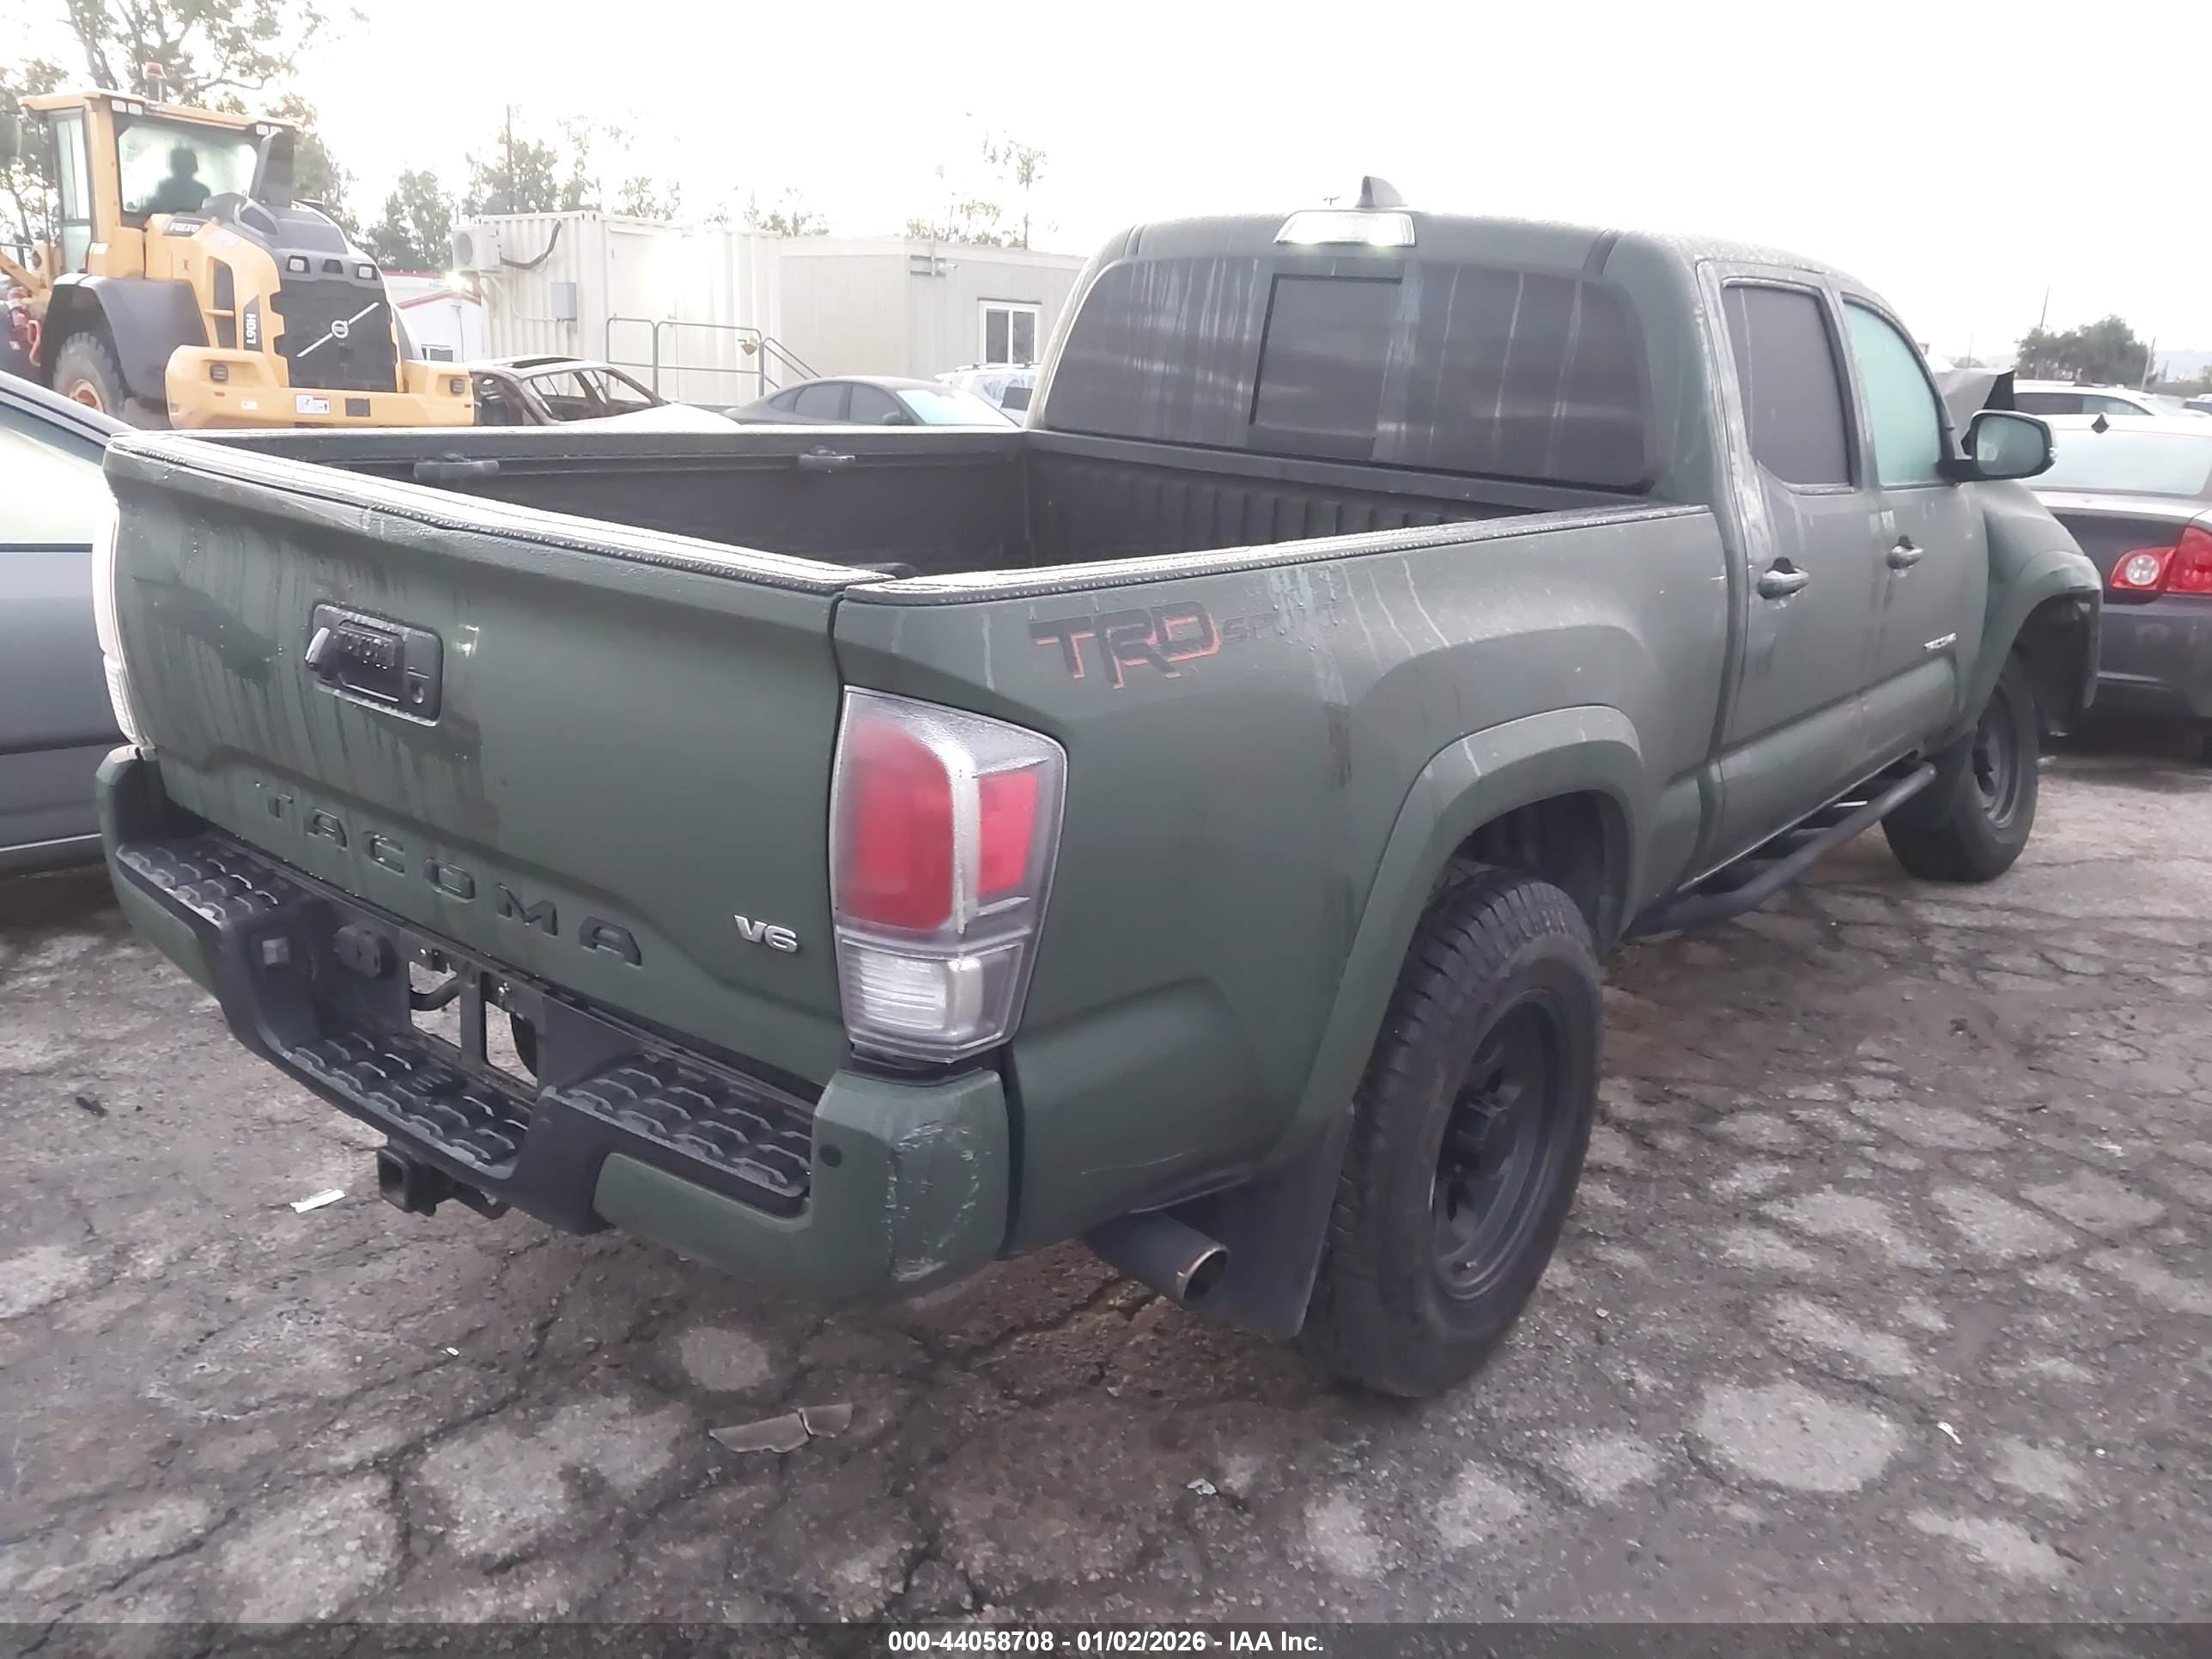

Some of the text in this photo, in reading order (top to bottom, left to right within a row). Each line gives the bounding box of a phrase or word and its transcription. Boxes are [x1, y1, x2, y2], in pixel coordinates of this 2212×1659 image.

[246, 313, 257, 344] L90H
[1029, 599, 1223, 690] TRD
[256, 781, 642, 966] TACOMA
[734, 914, 798, 953] V6
